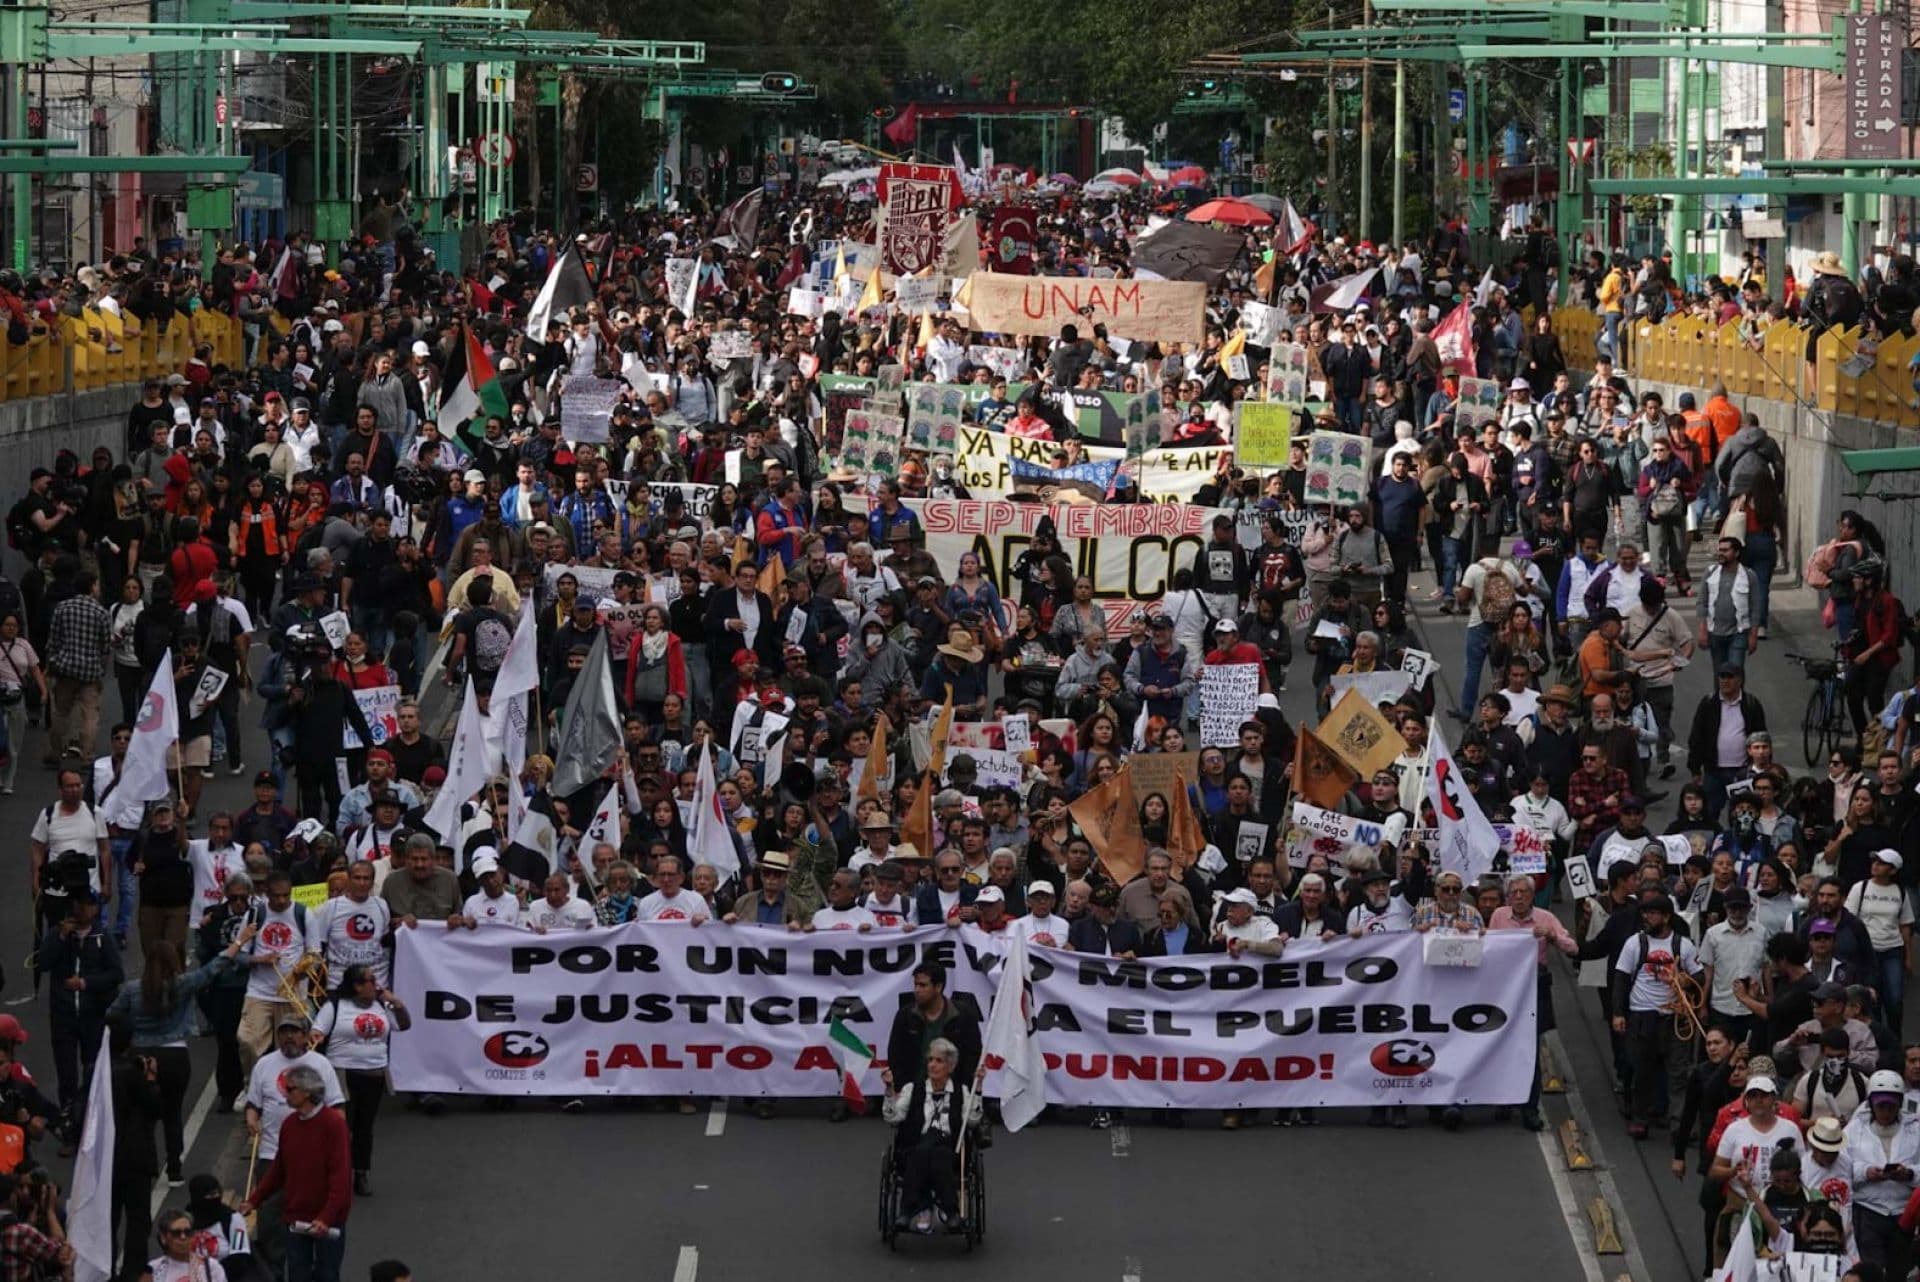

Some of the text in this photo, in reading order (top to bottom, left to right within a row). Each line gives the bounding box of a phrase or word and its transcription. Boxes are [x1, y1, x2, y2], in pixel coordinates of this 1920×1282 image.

[1854, 17, 1869, 138] VERIFICENTRO
[1880, 21, 1892, 108] ENTRADA
[1023, 281, 1140, 320] UNAM
[961, 427, 994, 457] YA
[956, 453, 967, 470] A
[963, 471, 992, 488] LOS
[922, 499, 1206, 539] SEPTIEMBRE
[1353, 822, 1381, 847] NO
[511, 944, 660, 974] POR
[686, 946, 788, 975] UN
[1077, 956, 1398, 991] MODELO
[425, 990, 516, 1021] DE
[542, 993, 873, 1025] JUSTICIA
[1107, 1008, 1191, 1037] EL
[1216, 1003, 1508, 1038] PUEBLO
[485, 1069, 527, 1081] COMITE
[584, 1043, 772, 1077] ¡ALTO
[1372, 1078, 1415, 1089] COMITE
